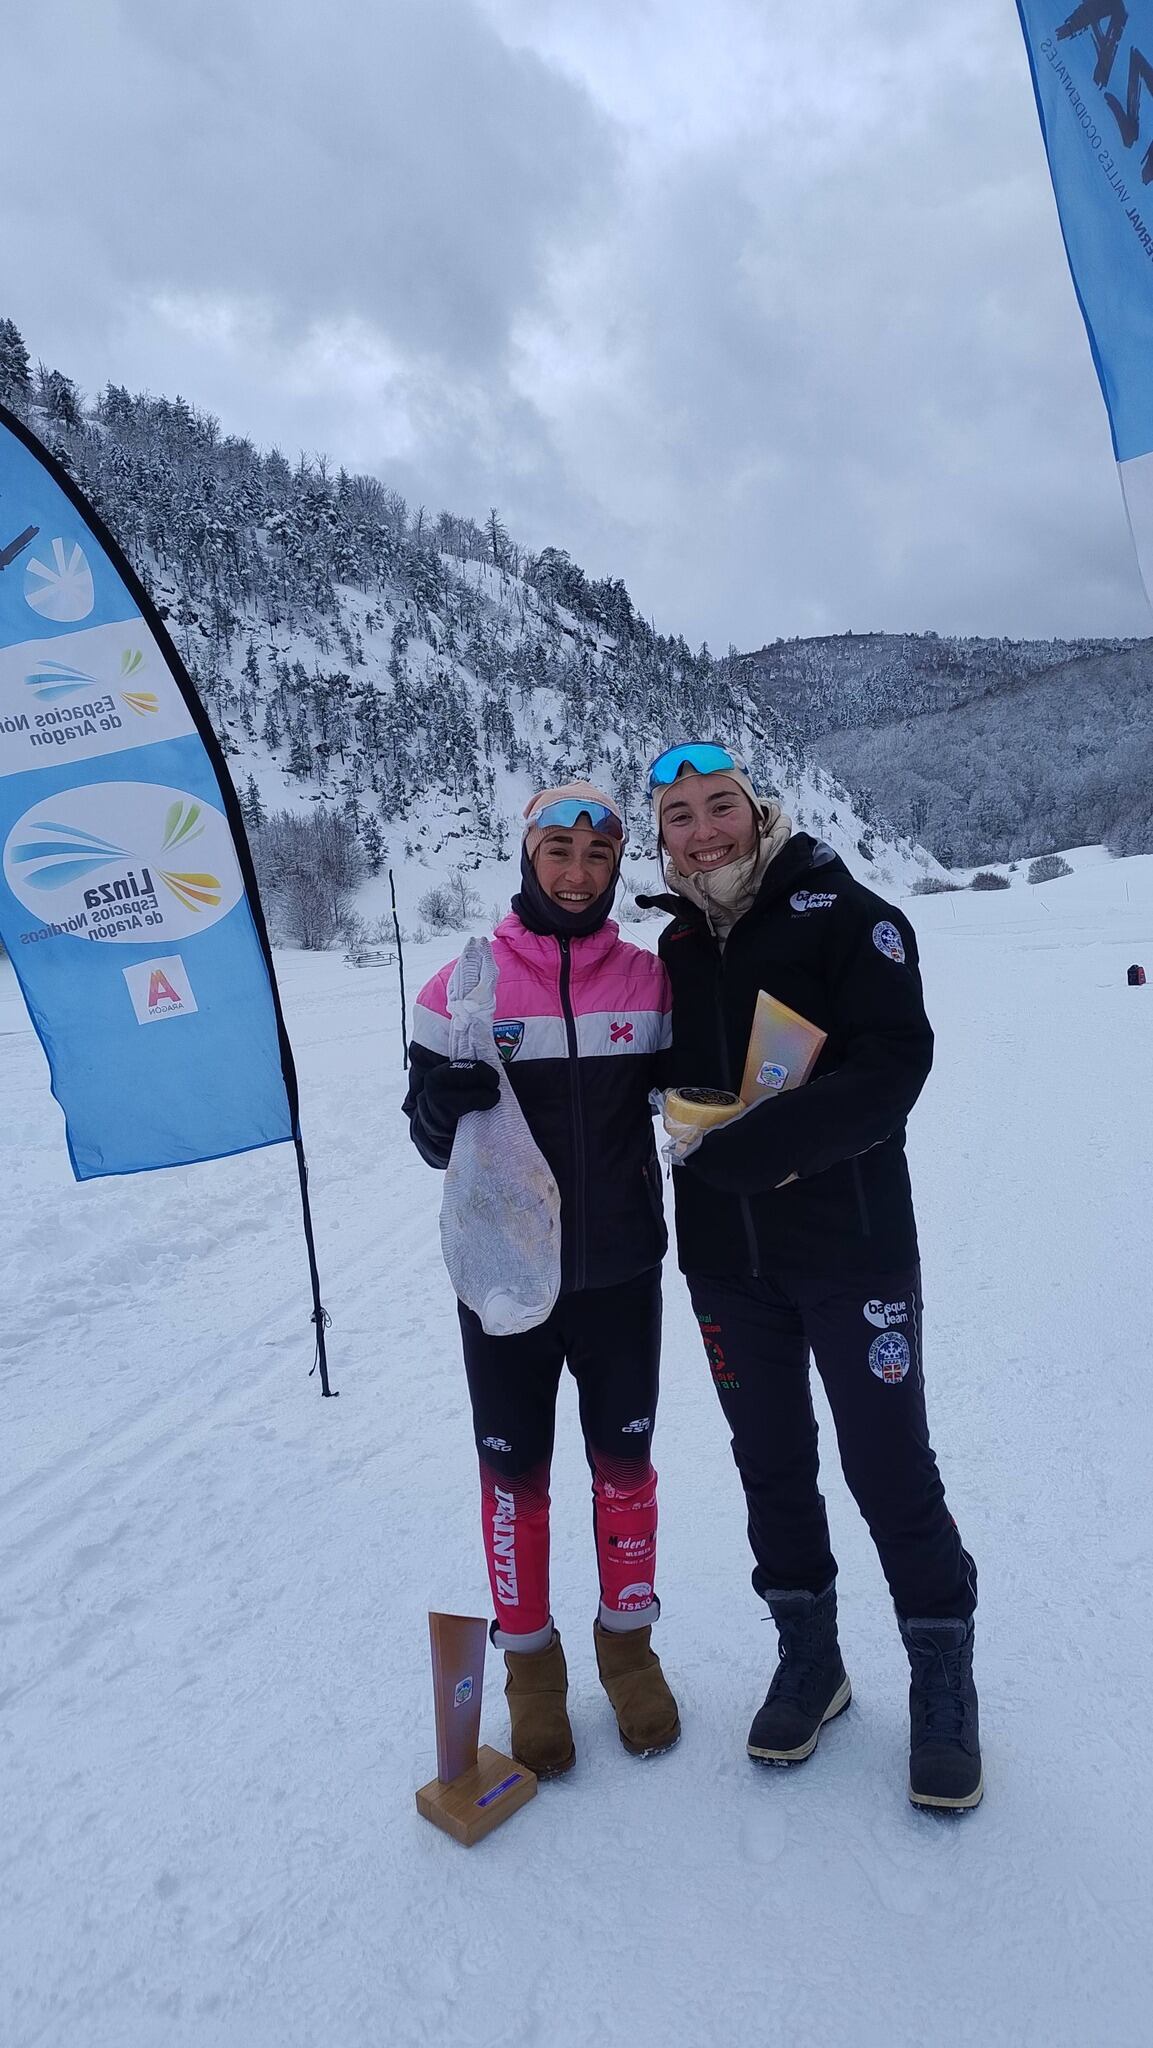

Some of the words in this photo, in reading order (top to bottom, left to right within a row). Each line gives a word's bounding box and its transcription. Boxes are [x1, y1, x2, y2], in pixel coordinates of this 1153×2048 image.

[868, 1301, 906, 1314] basque
[884, 1312, 909, 1325] team
[618, 1597, 652, 1611] ITSASO
